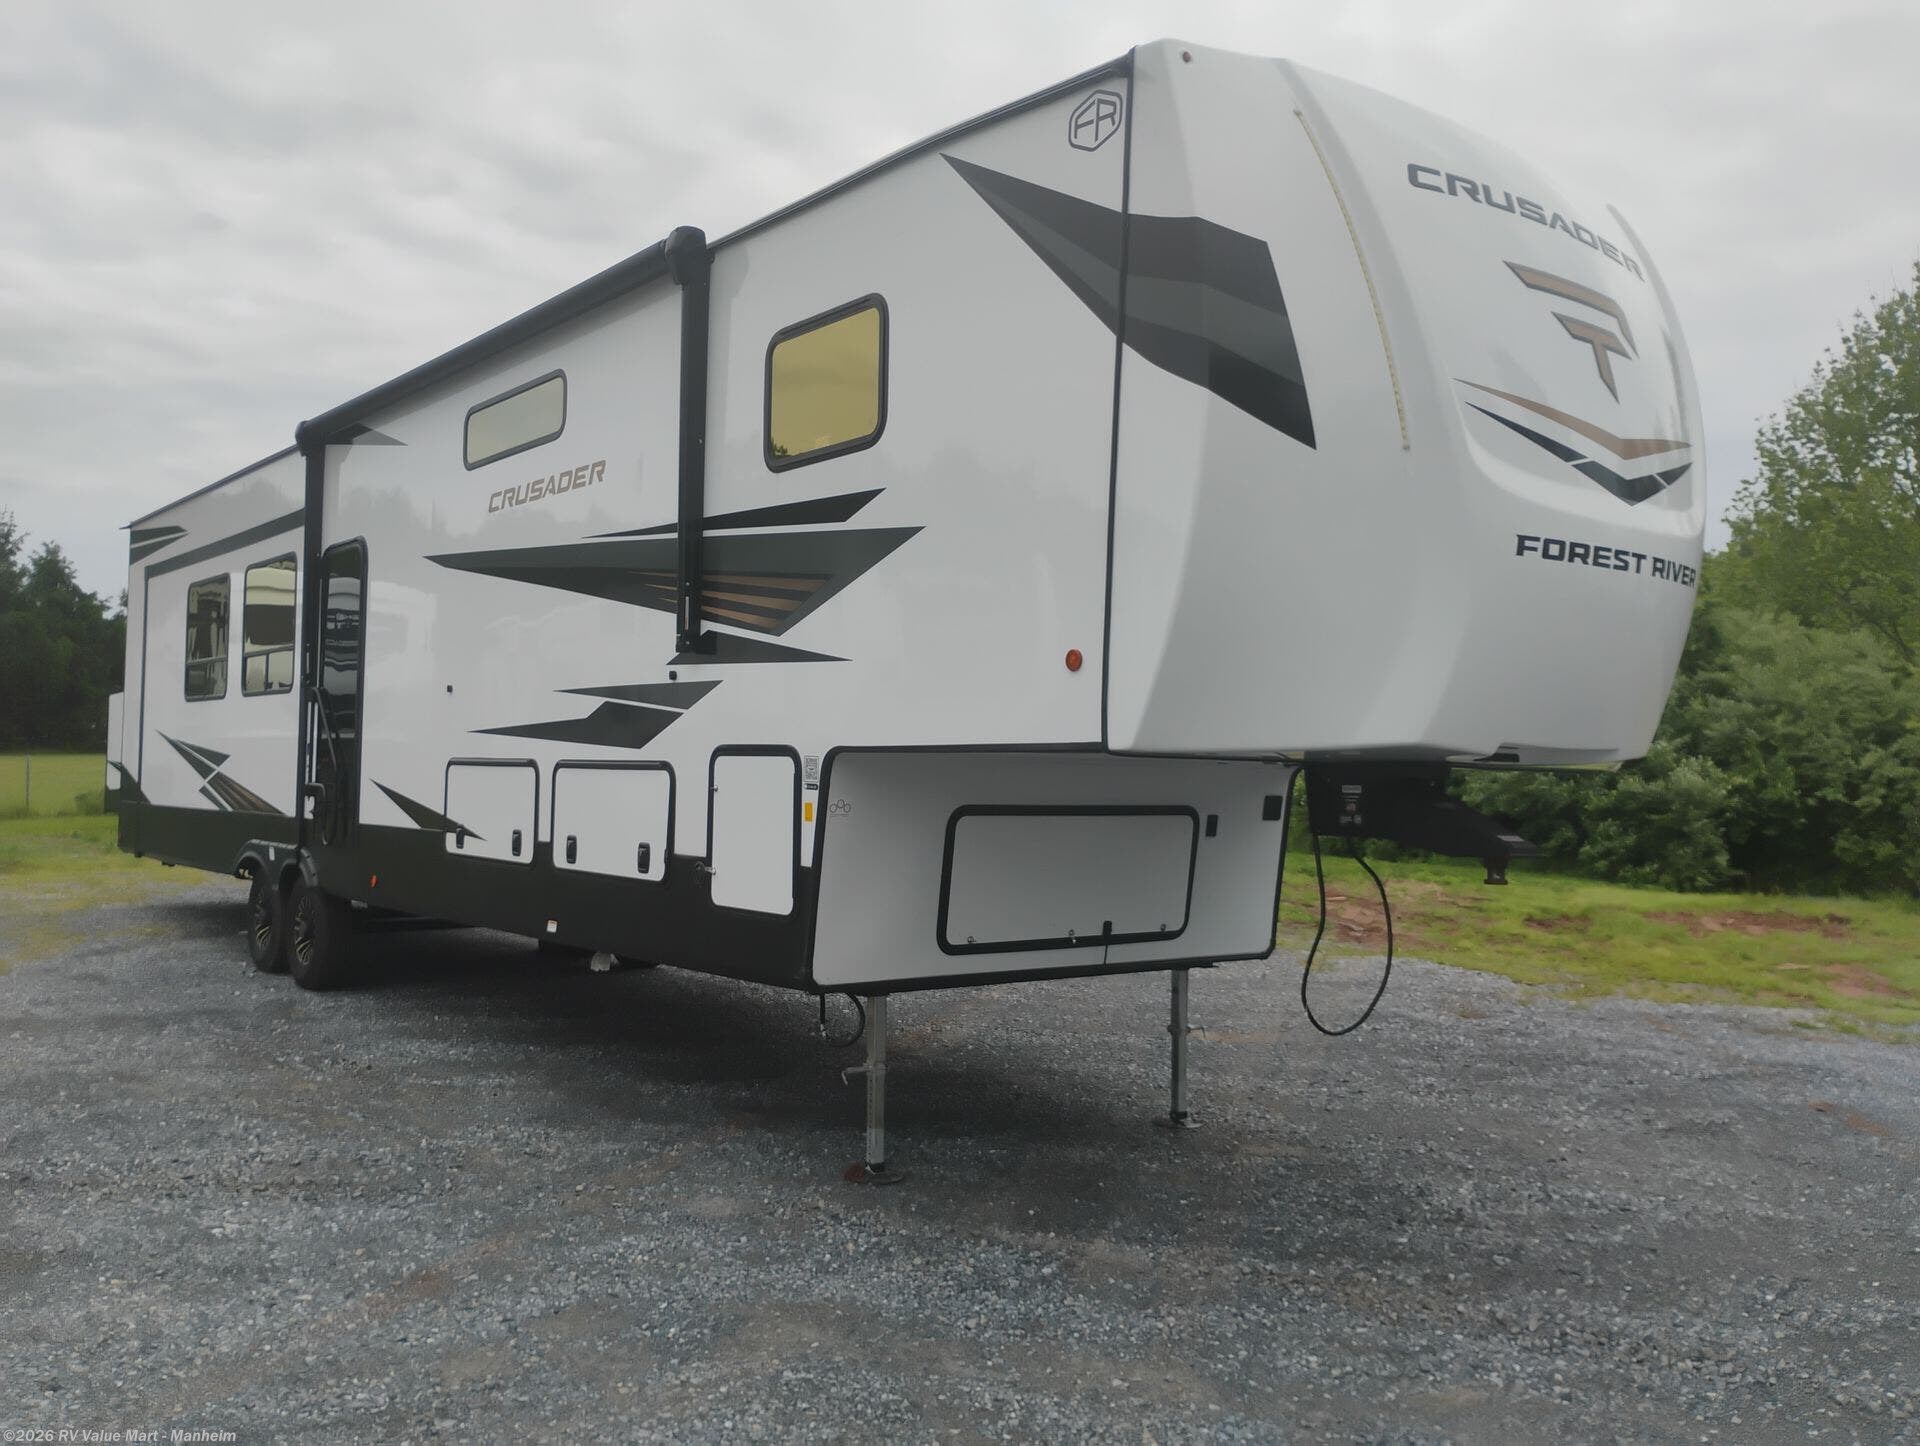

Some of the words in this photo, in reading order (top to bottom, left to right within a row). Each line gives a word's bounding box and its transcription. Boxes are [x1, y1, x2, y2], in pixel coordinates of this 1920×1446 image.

[1407, 163, 1645, 281] CRUSADER
[488, 459, 607, 513] CRUSADER
[1516, 534, 1647, 575] FOREST
[1651, 556, 1696, 588] RIVER
